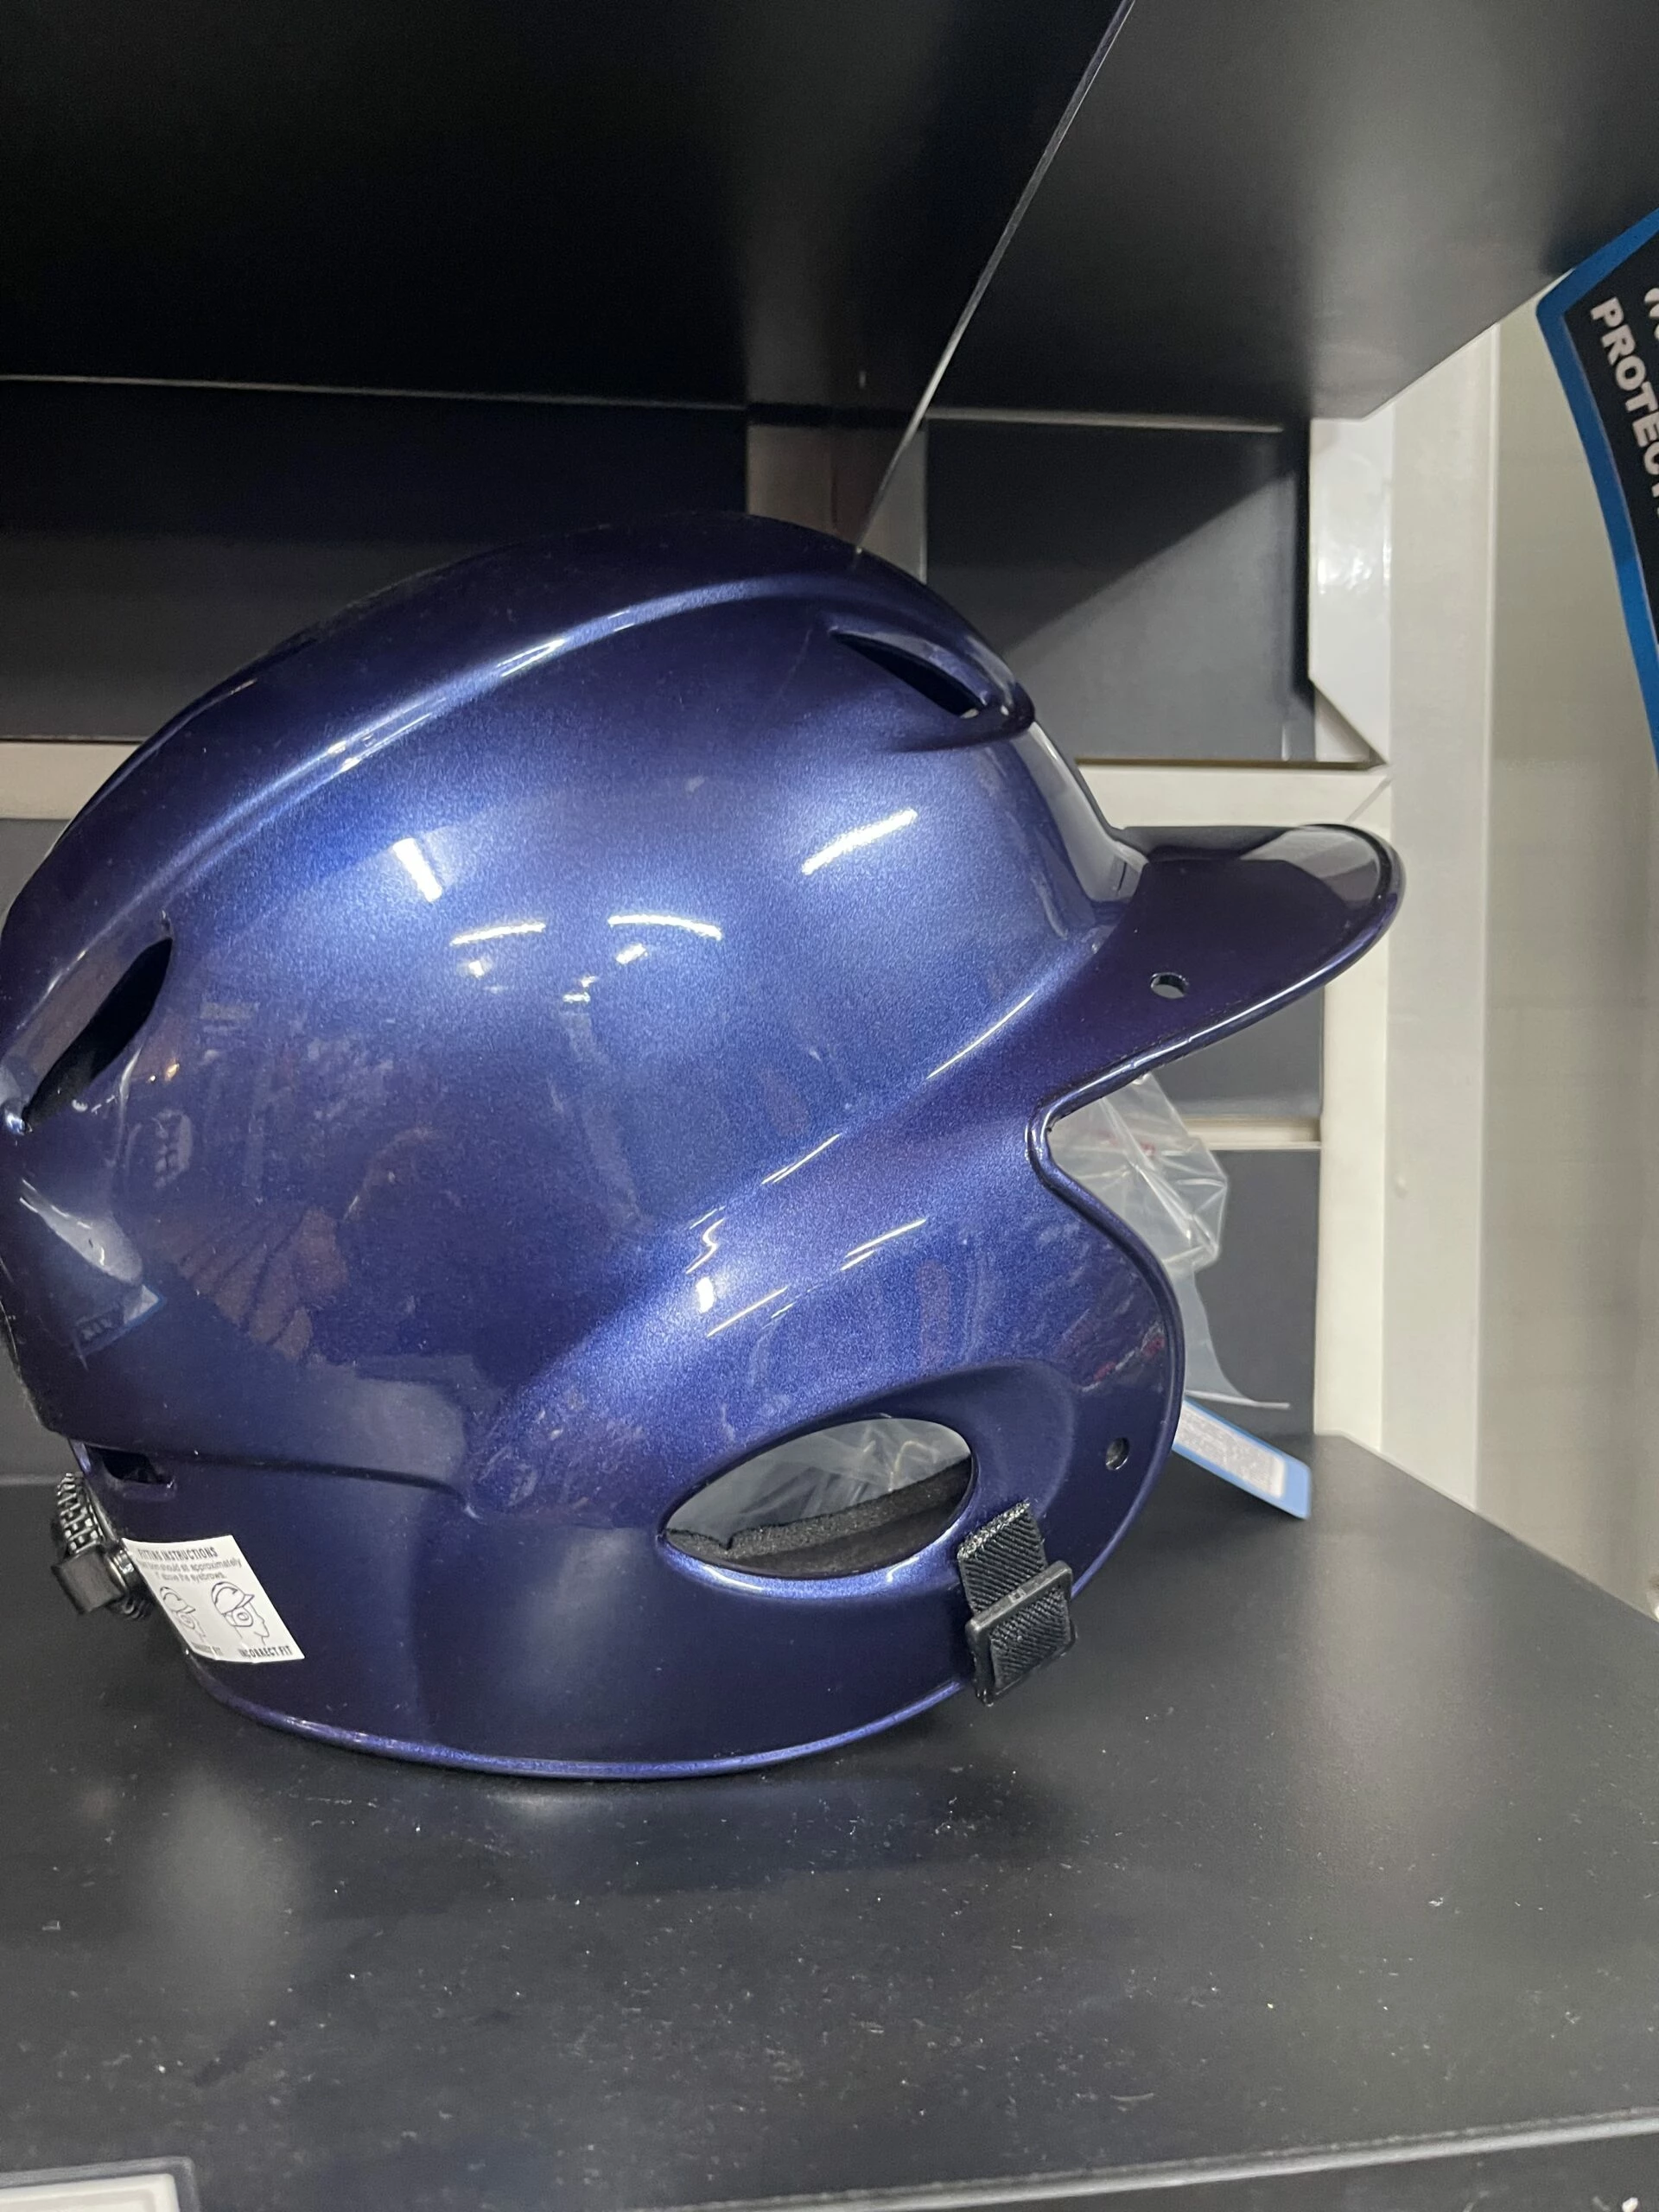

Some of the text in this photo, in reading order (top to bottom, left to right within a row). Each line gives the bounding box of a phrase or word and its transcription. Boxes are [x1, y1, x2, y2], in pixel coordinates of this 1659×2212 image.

[1590, 296, 1659, 518] PROTEC
[161, 1547, 218, 1560] INSTRUCTIONS
[190, 1558, 243, 1573] approximately
[237, 1645, 293, 1658] INCORRECT FIT
